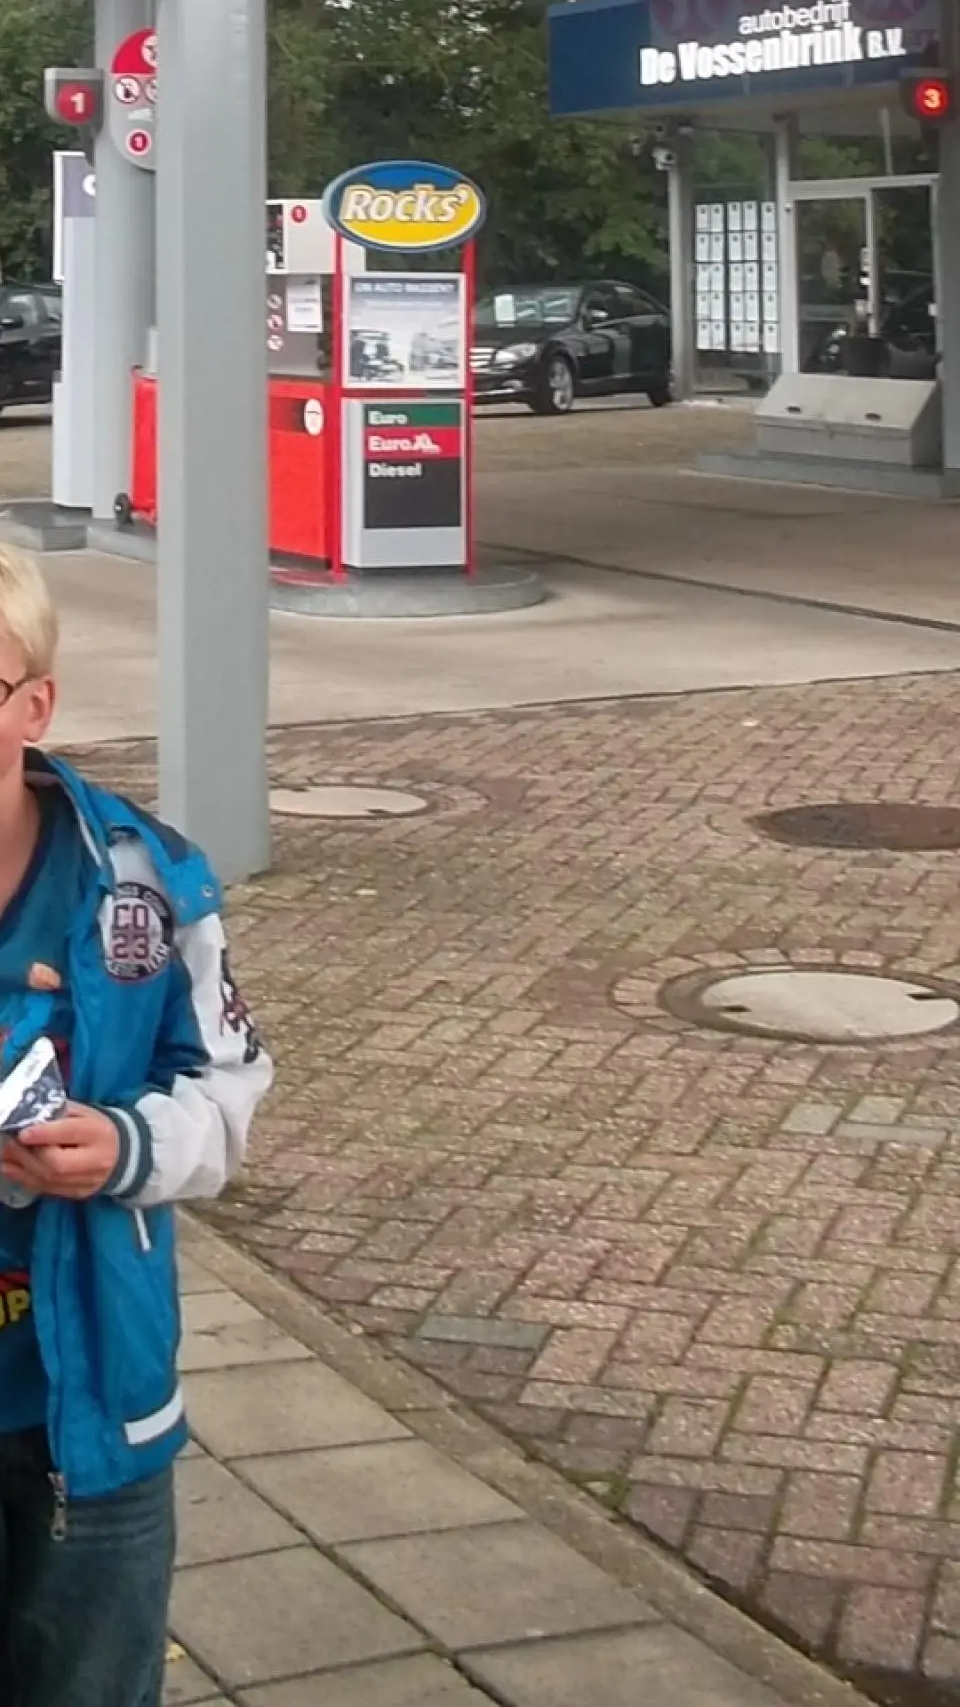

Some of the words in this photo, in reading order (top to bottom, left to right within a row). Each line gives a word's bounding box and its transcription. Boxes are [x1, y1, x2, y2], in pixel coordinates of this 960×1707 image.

[640, 47, 677, 85] De
[678, 22, 864, 80] Vossenbrink
[70, 92, 85, 114] 1
[923, 88, 941, 108] 3
[368, 410, 408, 425] Euro
[368, 435, 410, 452] Euro
[368, 462, 422, 478] Diesel
[114, 934, 148, 960] 23
